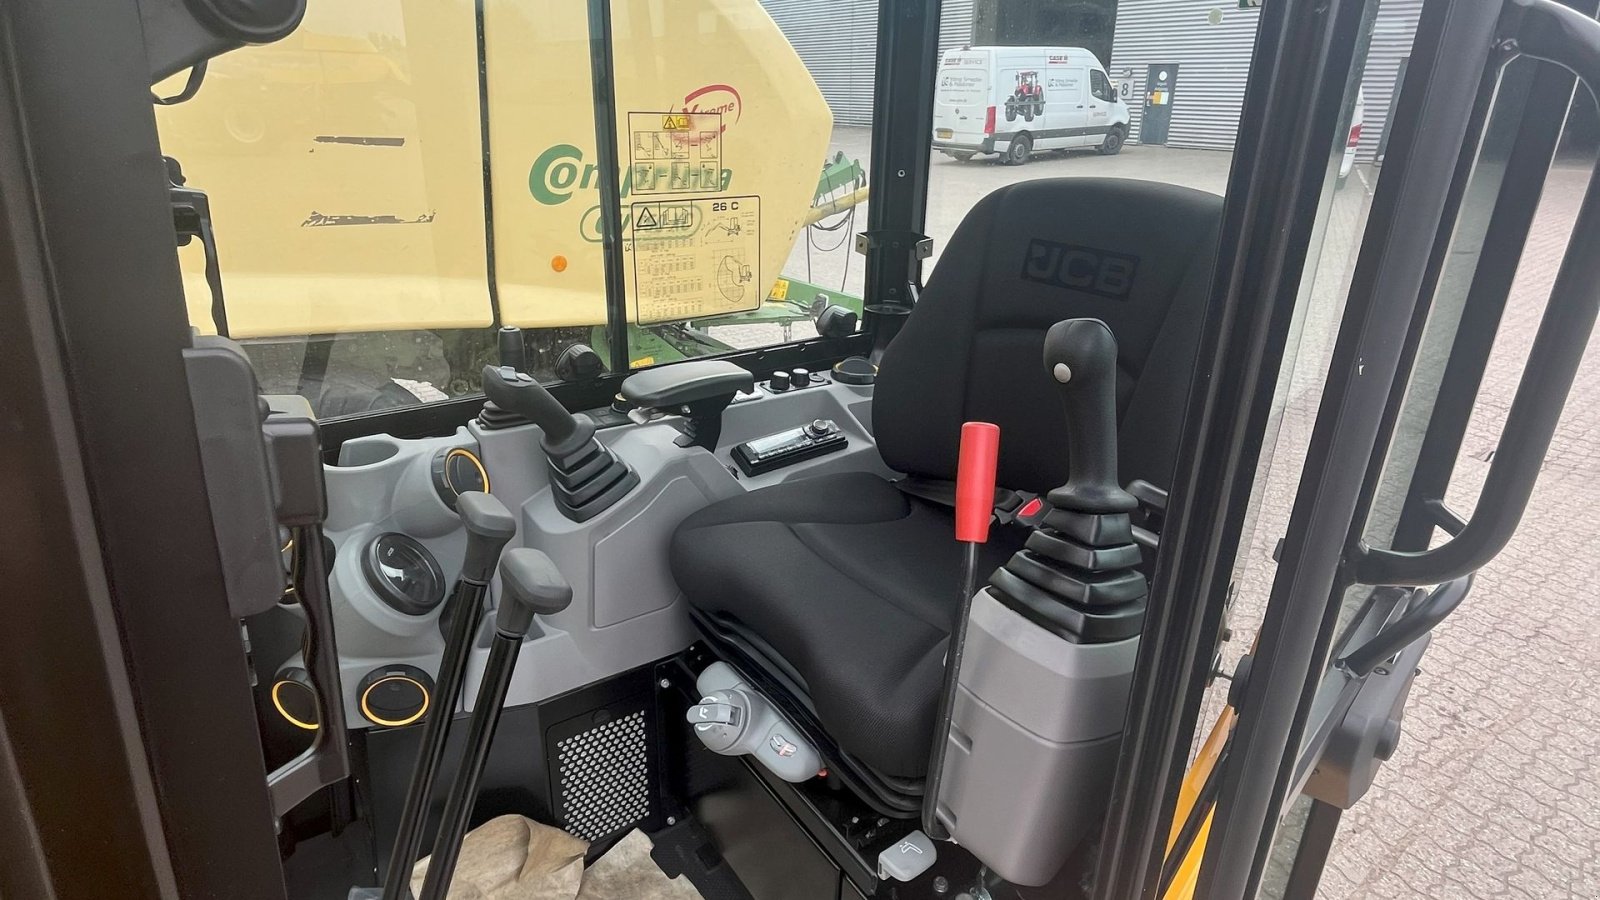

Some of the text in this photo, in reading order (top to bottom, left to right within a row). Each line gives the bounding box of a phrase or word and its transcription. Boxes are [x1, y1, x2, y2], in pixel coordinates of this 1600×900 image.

[1121, 83, 1129, 96] 8
[712, 201, 739, 211] 26 C
[1026, 243, 1135, 296] JCB
